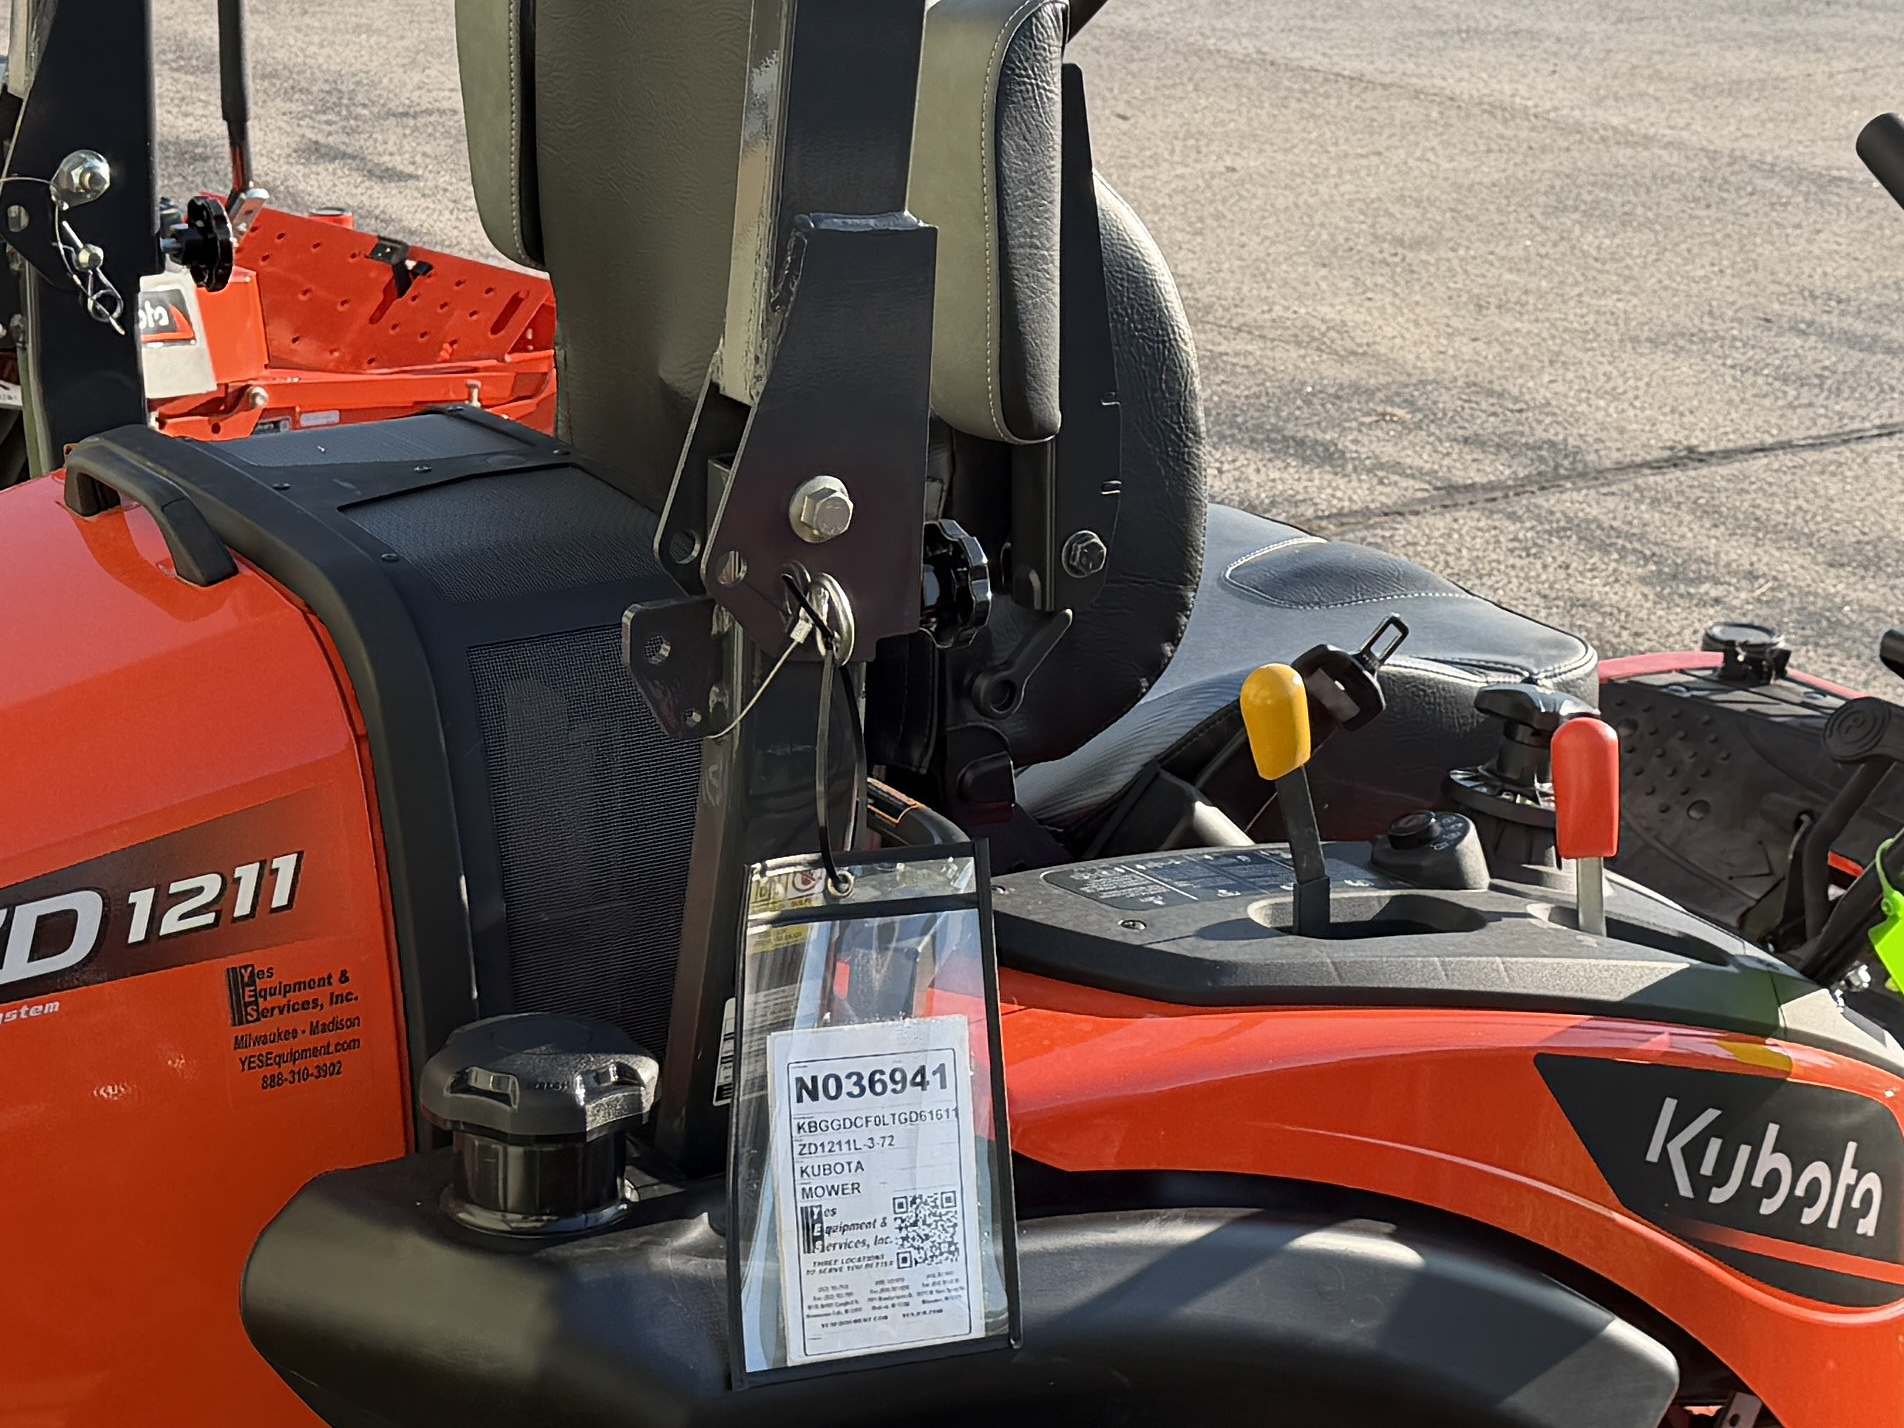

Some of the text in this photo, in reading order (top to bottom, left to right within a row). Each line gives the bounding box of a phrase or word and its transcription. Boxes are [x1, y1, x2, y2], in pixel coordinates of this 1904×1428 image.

[241, 966, 274, 983] Yes
[245, 969, 350, 1002] Equipment &
[247, 990, 359, 1021] Services, Inc.
[234, 1015, 360, 1050] Milwaukee Madison
[239, 1037, 361, 1072] YESEquipment.com
[261, 1060, 342, 1090] 888-310-3902
[795, 1063, 947, 1103] N036941
[798, 1135, 895, 1156] ZD1211L-3-72
[800, 1160, 865, 1178] KUBOTA
[1645, 1097, 1883, 1237] Kubota
[801, 1182, 861, 1199] MOWER
[813, 1217, 876, 1236] Equipment
[874, 1235, 894, 1246] Inc.
